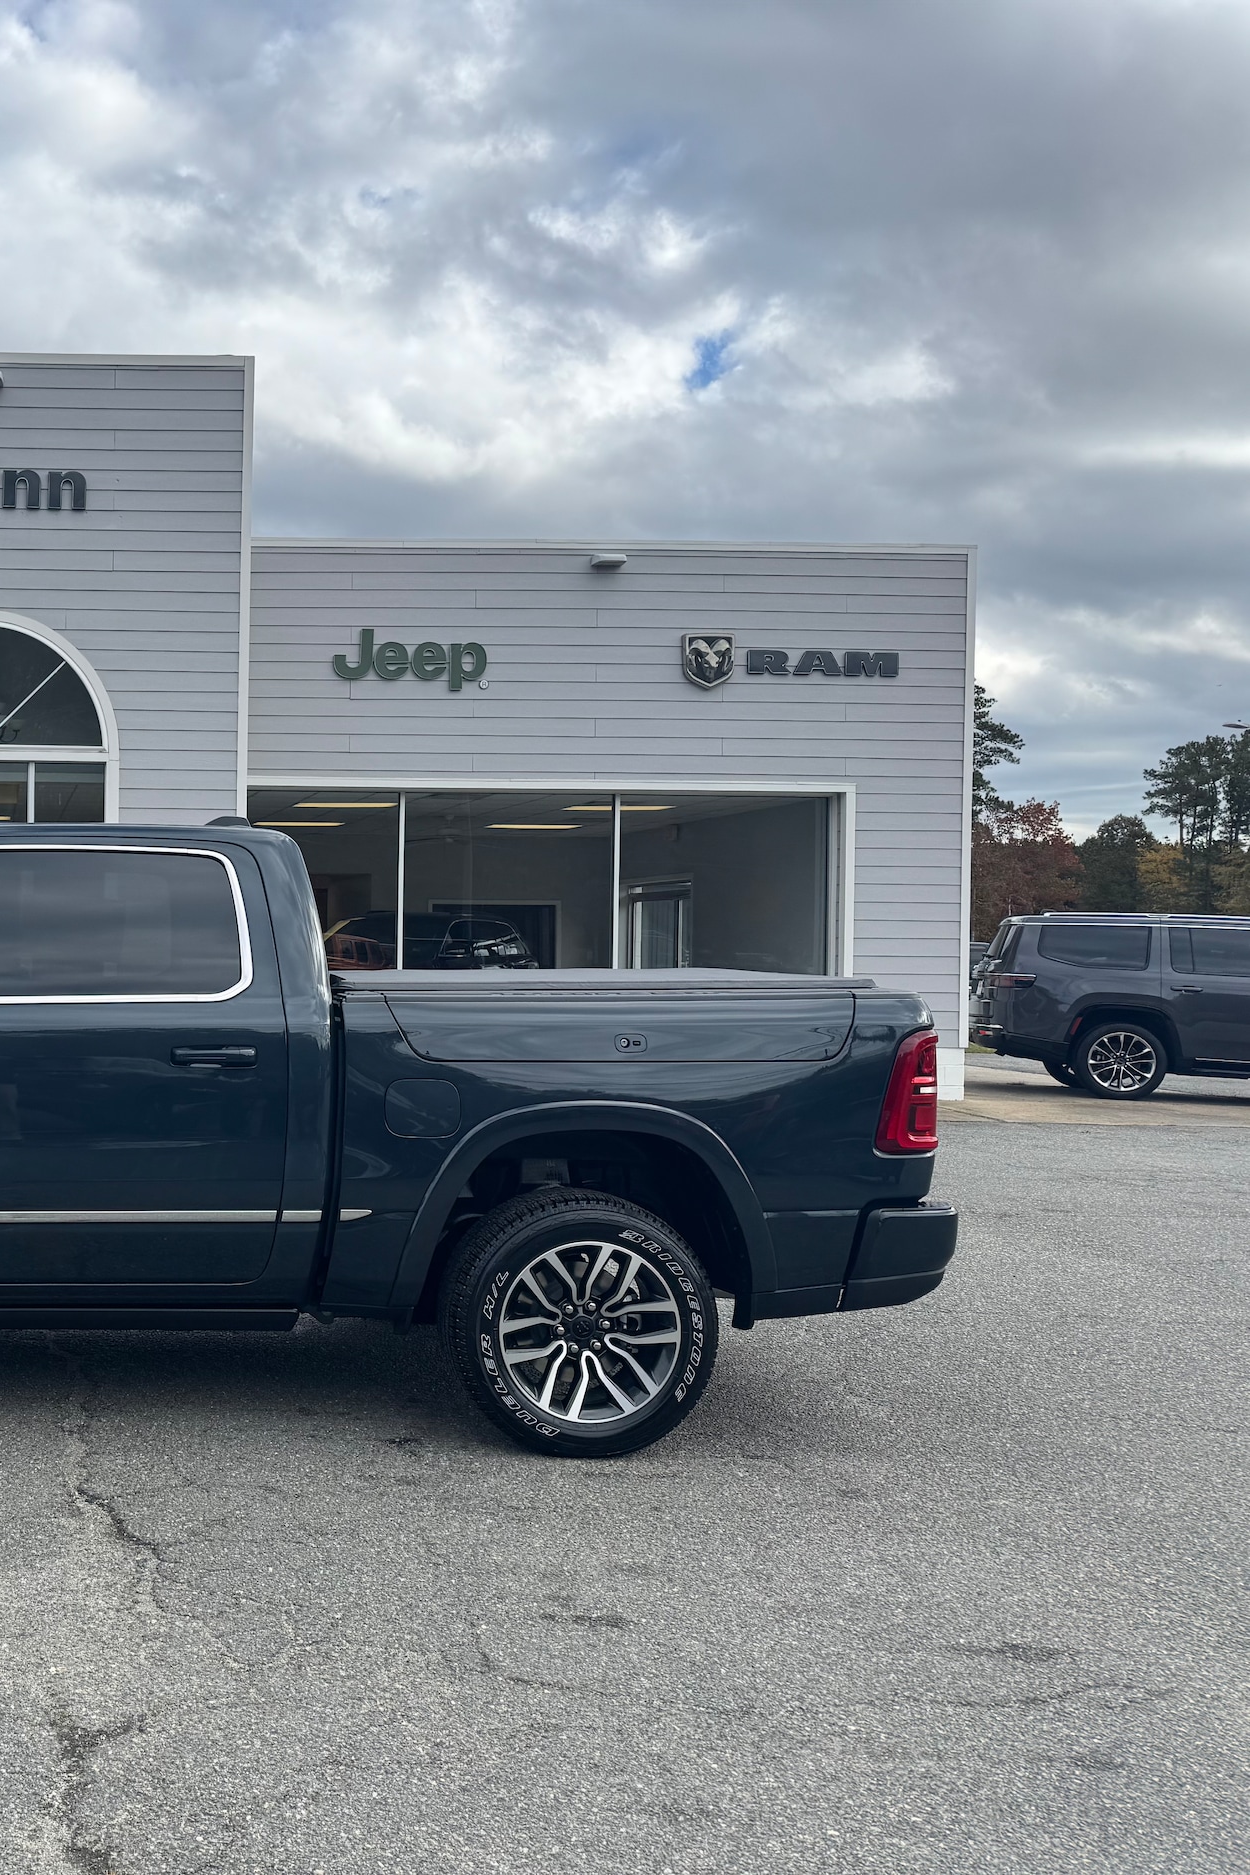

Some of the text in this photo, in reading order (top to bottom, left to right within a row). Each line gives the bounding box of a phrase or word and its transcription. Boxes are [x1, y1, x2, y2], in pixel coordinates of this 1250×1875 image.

[333, 628, 488, 691] Jeep
[746, 649, 900, 677] RAM
[480, 1270, 561, 1437] DUELER H/L
[617, 1228, 704, 1403] BRIDGESTONE
